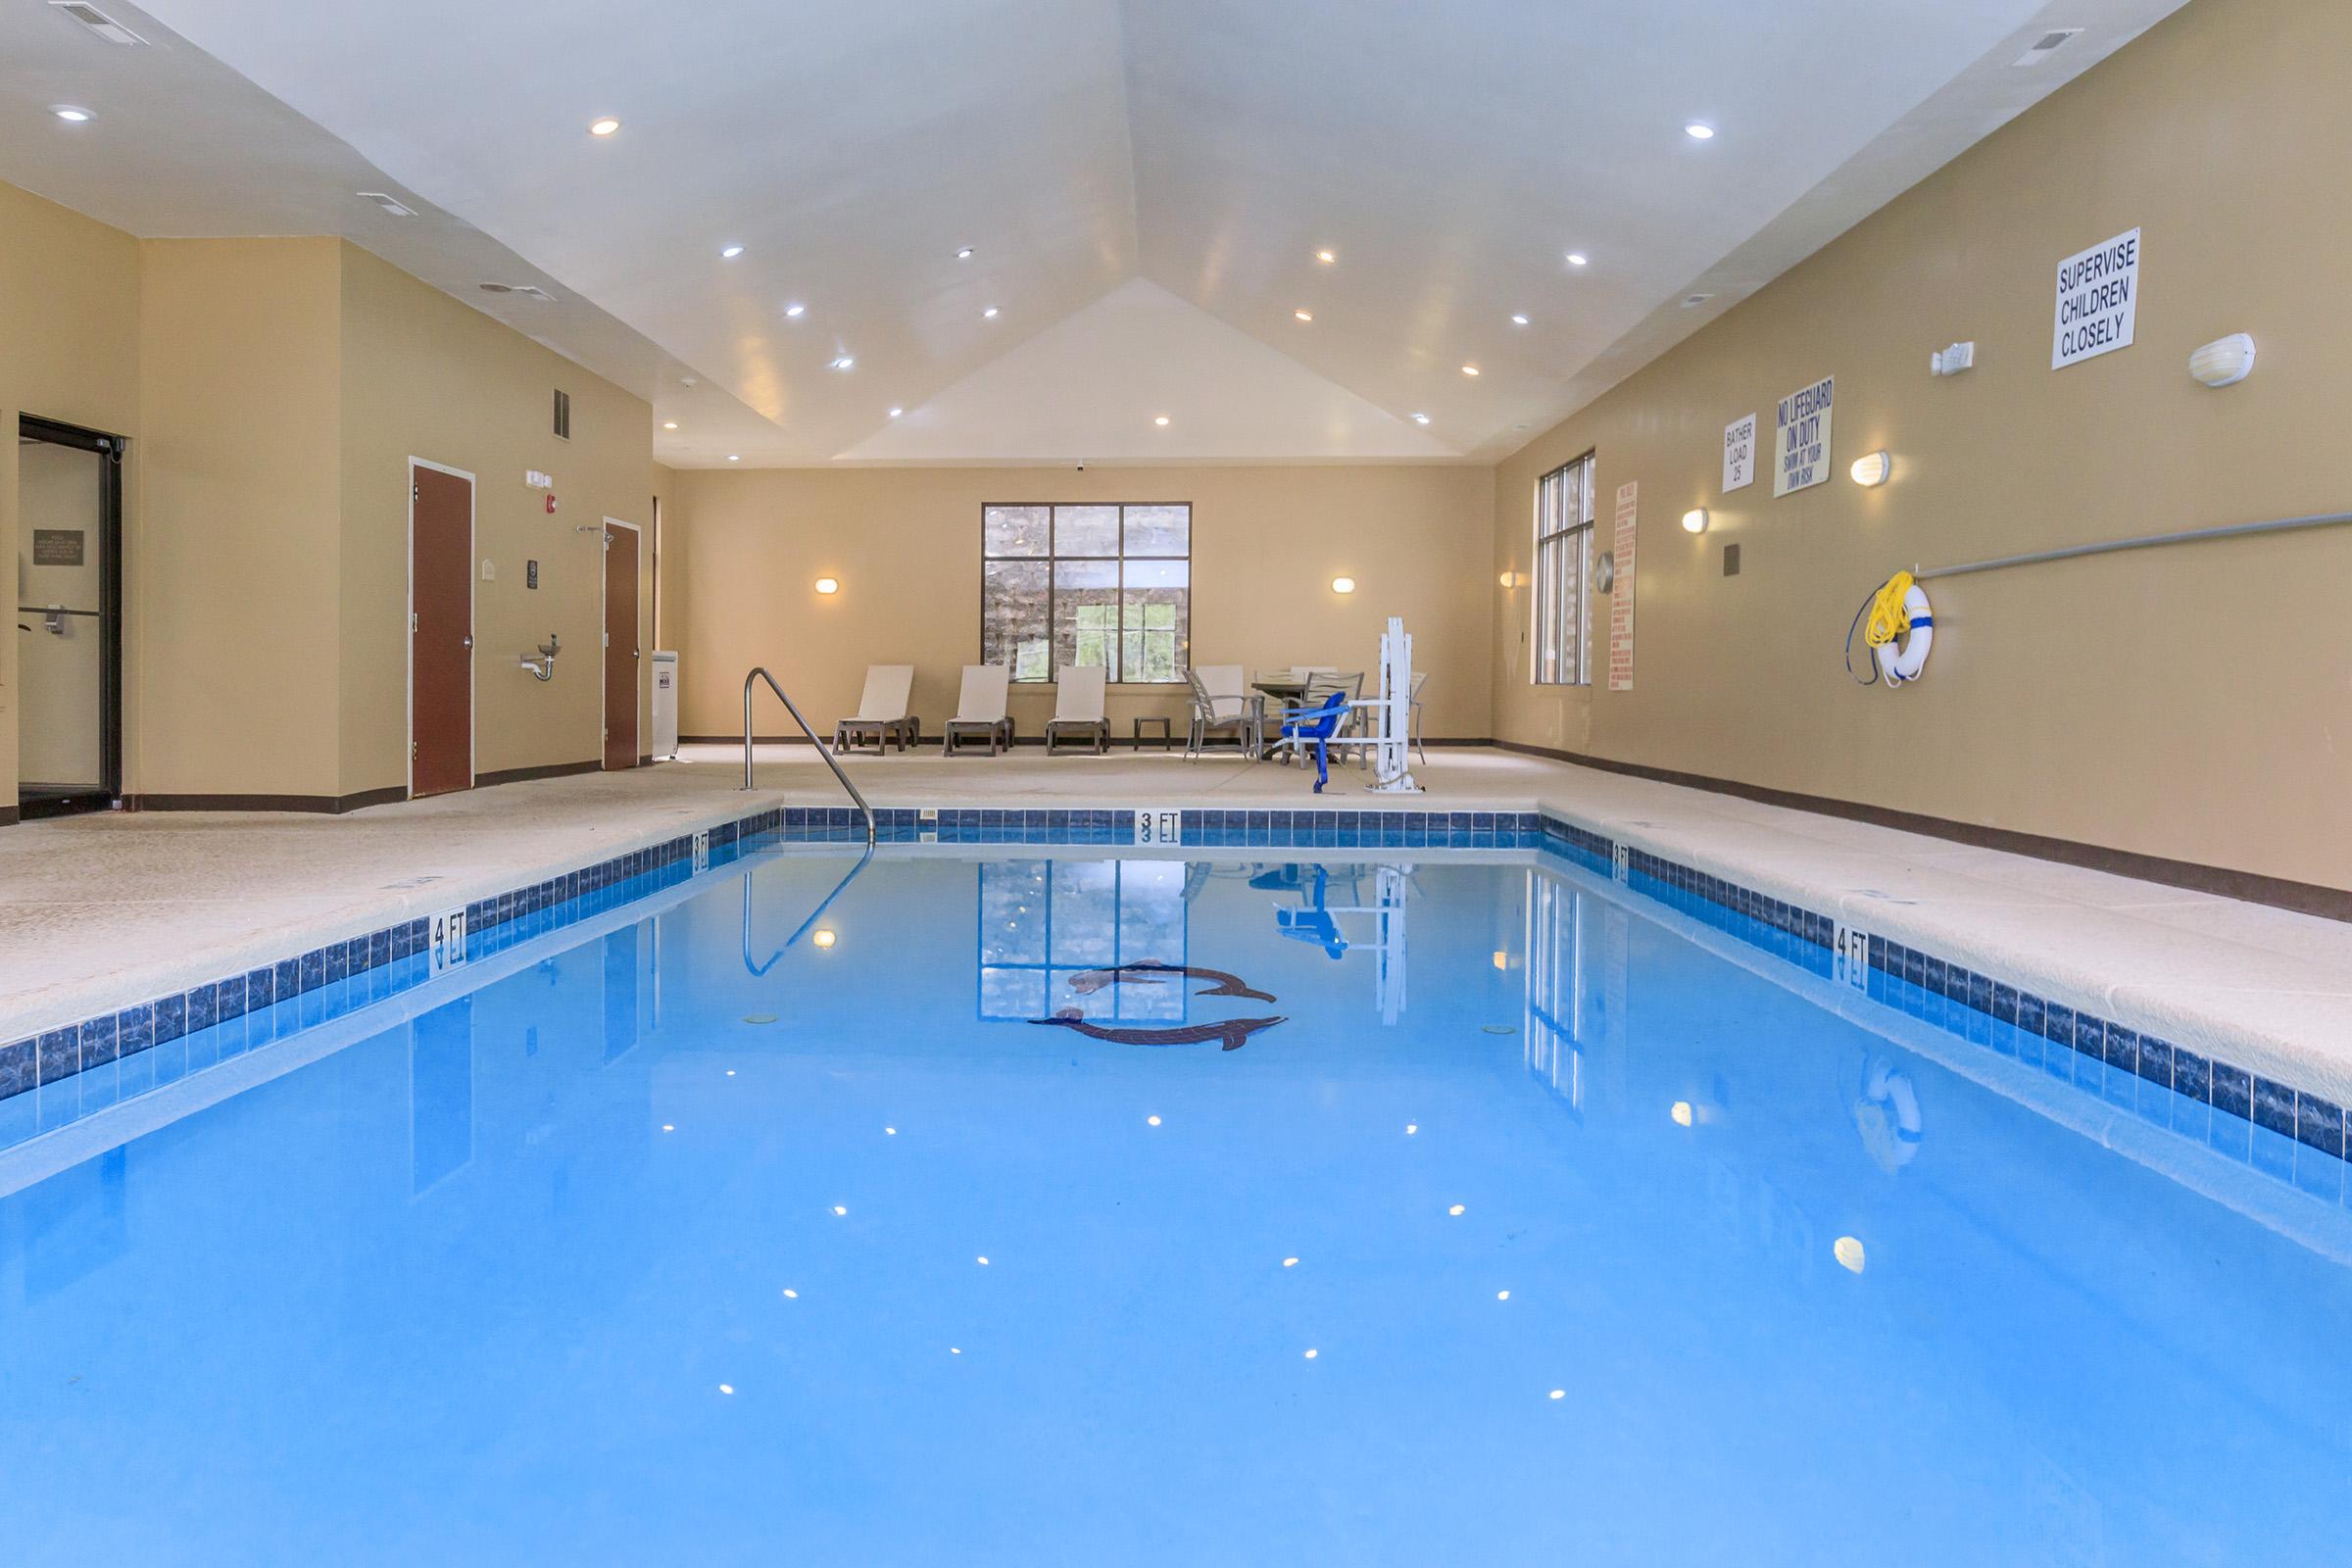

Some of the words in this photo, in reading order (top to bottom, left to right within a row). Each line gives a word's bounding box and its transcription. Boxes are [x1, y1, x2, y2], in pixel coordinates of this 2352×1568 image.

[2060, 239, 2135, 293] SUPERVISE
[2062, 275, 2130, 324] CHILDREN
[2062, 312, 2125, 357] CLOSELY
[1778, 401, 1788, 428] NO
[1790, 379, 1832, 422] LIFEGUARD
[1727, 422, 1751, 447] BATHER
[1787, 423, 1797, 453] ON
[1799, 414, 1820, 447] DUTY
[1730, 444, 1747, 465] LOAD
[1734, 465, 1741, 481] 25
[434, 917, 445, 945] 4
[450, 911, 465, 941] FT
[1838, 927, 1846, 956] 4
[1851, 930, 1866, 961] FT
